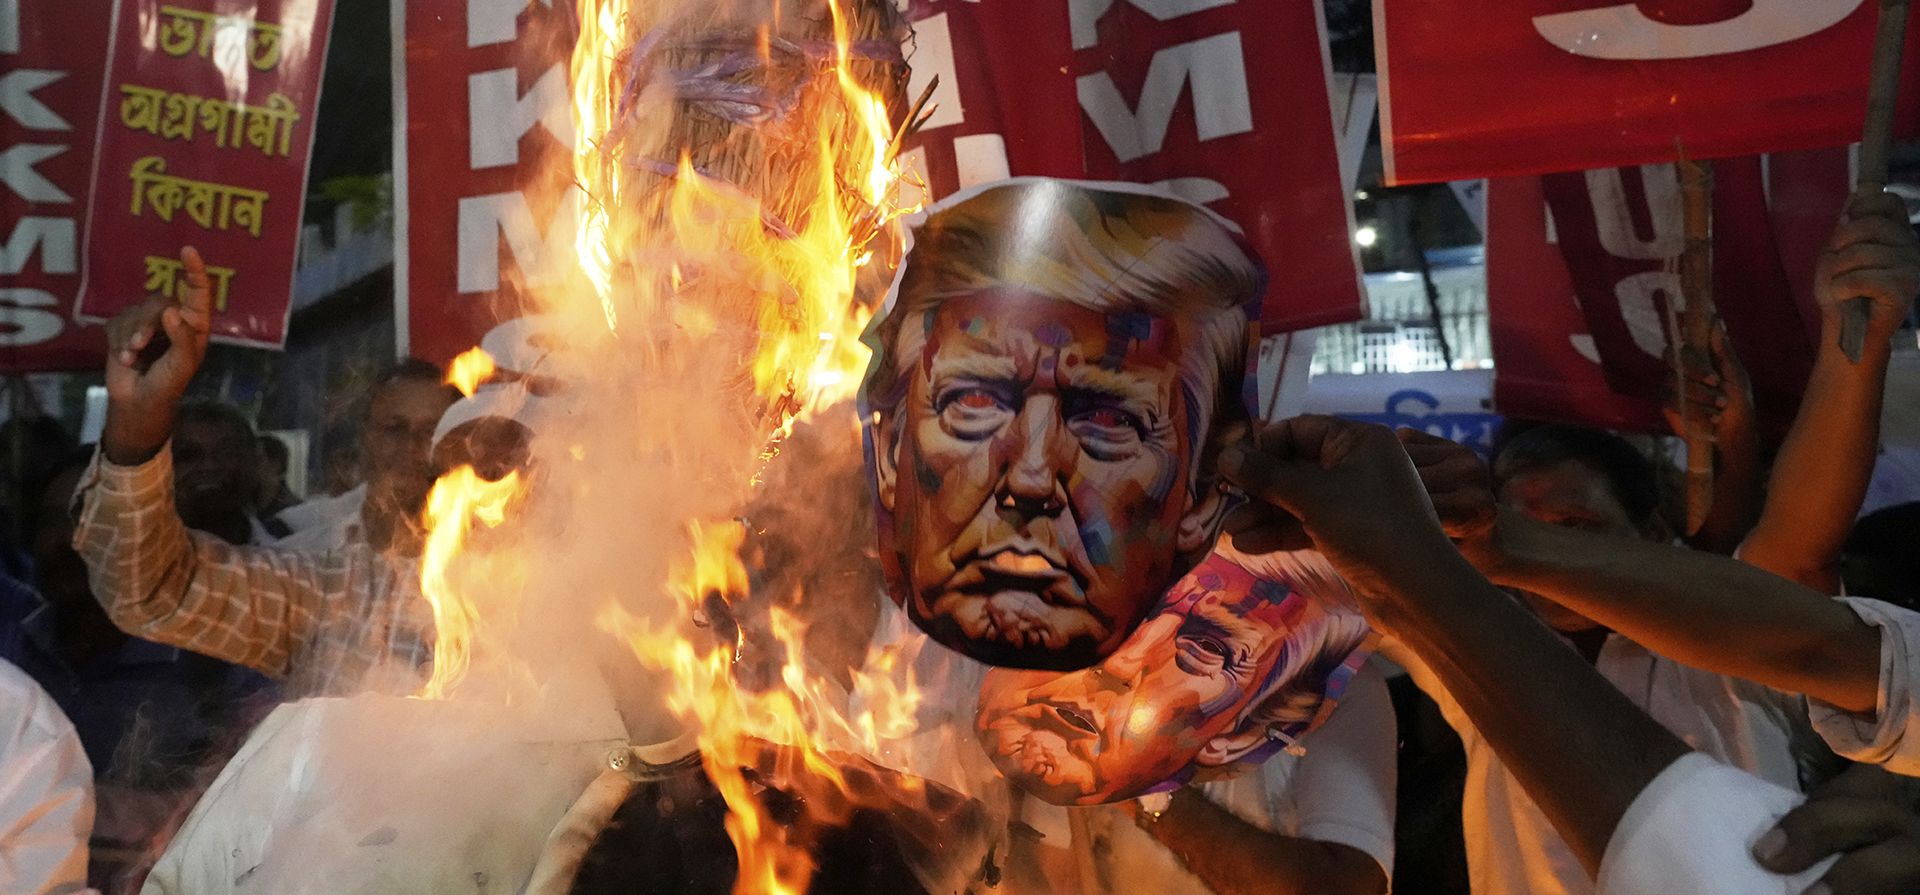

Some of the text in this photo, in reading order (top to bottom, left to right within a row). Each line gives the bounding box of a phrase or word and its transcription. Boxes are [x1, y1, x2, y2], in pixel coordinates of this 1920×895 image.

[160, 5, 282, 71] ভাত
[119, 84, 299, 157] অগ্রগামী
[129, 155, 270, 237] কিষান
[143, 255, 236, 312] সা
